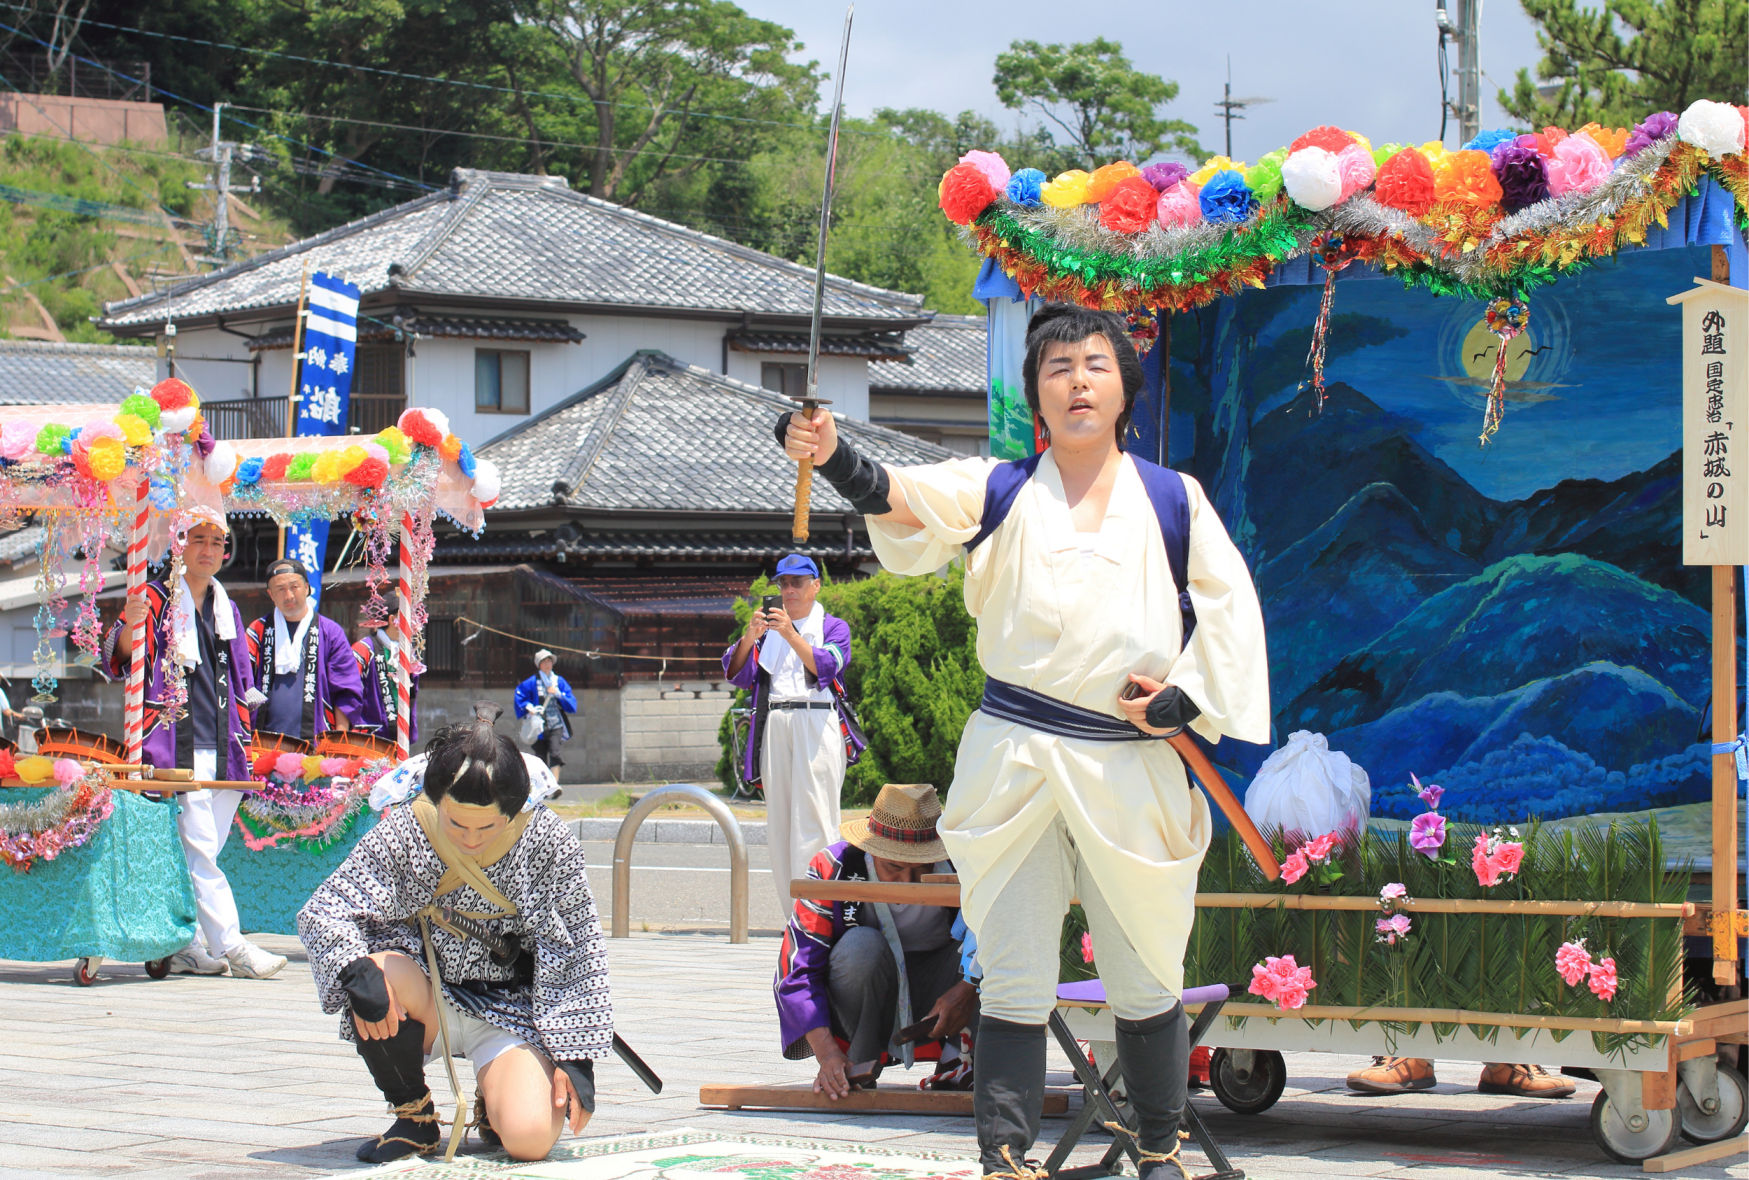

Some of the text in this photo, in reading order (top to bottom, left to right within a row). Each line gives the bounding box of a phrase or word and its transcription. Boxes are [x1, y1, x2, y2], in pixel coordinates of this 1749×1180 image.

[1702, 309, 1726, 355] 外題
[1706, 361, 1724, 423] 国定忠治
[218, 650, 228, 709] 宝くじ
[262, 626, 275, 697] 有川まつり振興
